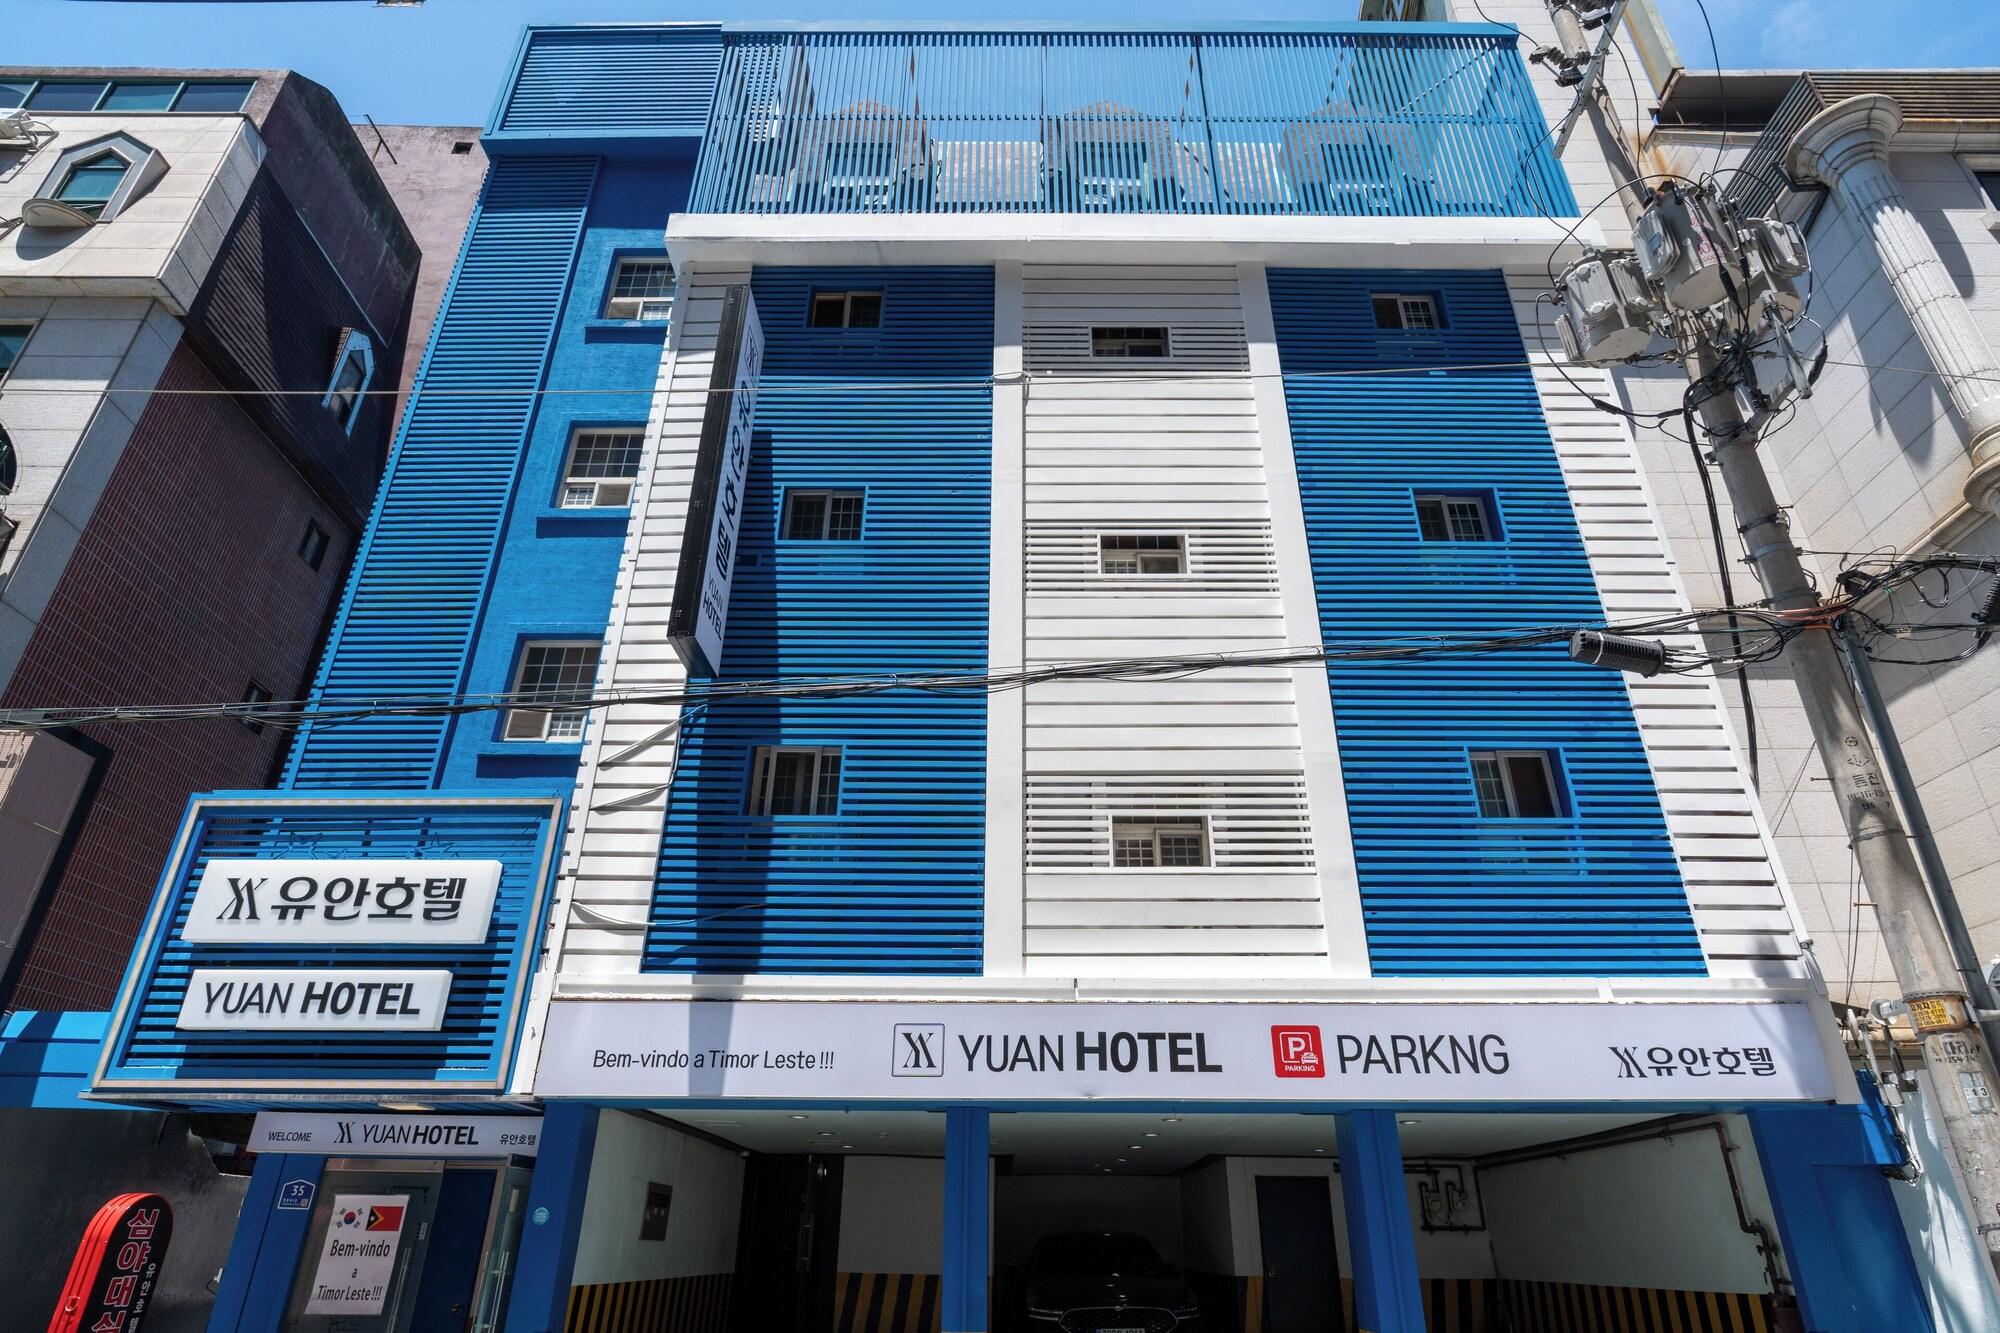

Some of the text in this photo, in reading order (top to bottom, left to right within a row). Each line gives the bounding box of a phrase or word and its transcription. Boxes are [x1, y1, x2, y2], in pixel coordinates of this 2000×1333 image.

[715, 380, 752, 581] 유안호텔
[708, 572, 724, 612] YUAN
[702, 591, 723, 641] HOTEL
[270, 876, 467, 921] 유안호텔
[205, 981, 421, 1015] YUAN HOTEL
[593, 1049, 689, 1069] Bem-vindo
[693, 1054, 705, 1069] a
[708, 1049, 760, 1069] Timor
[958, 1031, 1223, 1073] YUAN HOTEL
[1336, 1034, 1510, 1075] PARKNG
[1647, 1046, 1777, 1078] 유안호텔
[268, 1131, 313, 1142] WELCOME
[362, 1123, 479, 1146] YUAN HOTEL
[499, 1133, 538, 1147] 유안호텔
[291, 1185, 305, 1196] 35
[329, 1239, 391, 1257] Bem-vindo
[351, 1268, 358, 1279] a
[317, 1285, 345, 1301] Timor
